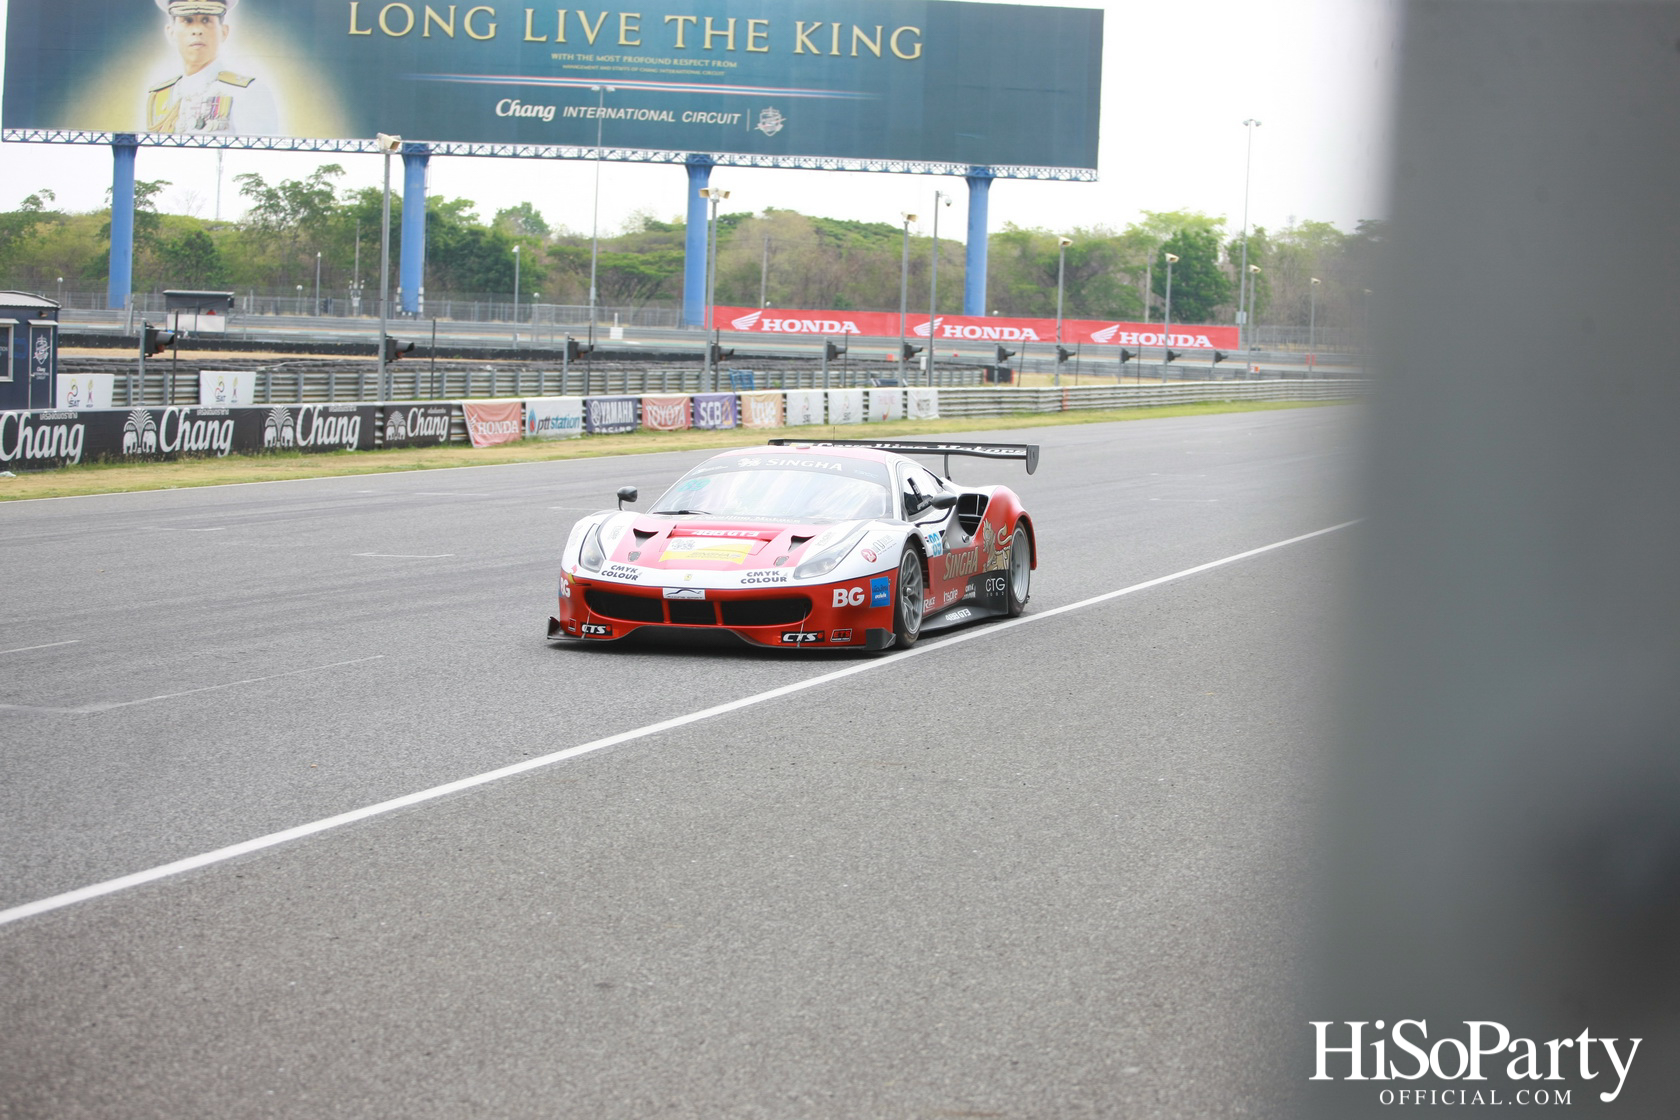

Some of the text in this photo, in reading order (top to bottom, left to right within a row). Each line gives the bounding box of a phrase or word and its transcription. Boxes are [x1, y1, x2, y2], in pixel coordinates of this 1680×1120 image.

[348, 1, 924, 60] LONG LIVE THE KING
[551, 53, 738, 68] WITH THE MOST PROFOUND RESPECT FROM
[496, 99, 742, 125] Chang INTERNATIONAL CIRCUIT
[761, 318, 861, 334] HONDA
[942, 324, 1041, 341] HONDA
[1119, 331, 1213, 347] HONDA
[600, 401, 634, 424] YAMAHA
[646, 404, 685, 426] TOYOTA
[700, 400, 721, 426] SCB
[750, 397, 777, 424] true
[160, 406, 235, 457] Chang
[296, 404, 361, 451] Chang
[407, 407, 449, 442] Chang
[478, 420, 520, 436] HONDA
[0, 411, 85, 464] Chang
[765, 457, 843, 472] SINGHA
[610, 564, 639, 573] CMYK
[943, 546, 979, 581] SINGHA
[601, 570, 639, 581] COLOUR
[985, 577, 1006, 592] CTG
[832, 587, 865, 608] BG
[957, 608, 972, 618] GT3
[581, 624, 607, 634] CTS
[782, 632, 818, 642] CTS
